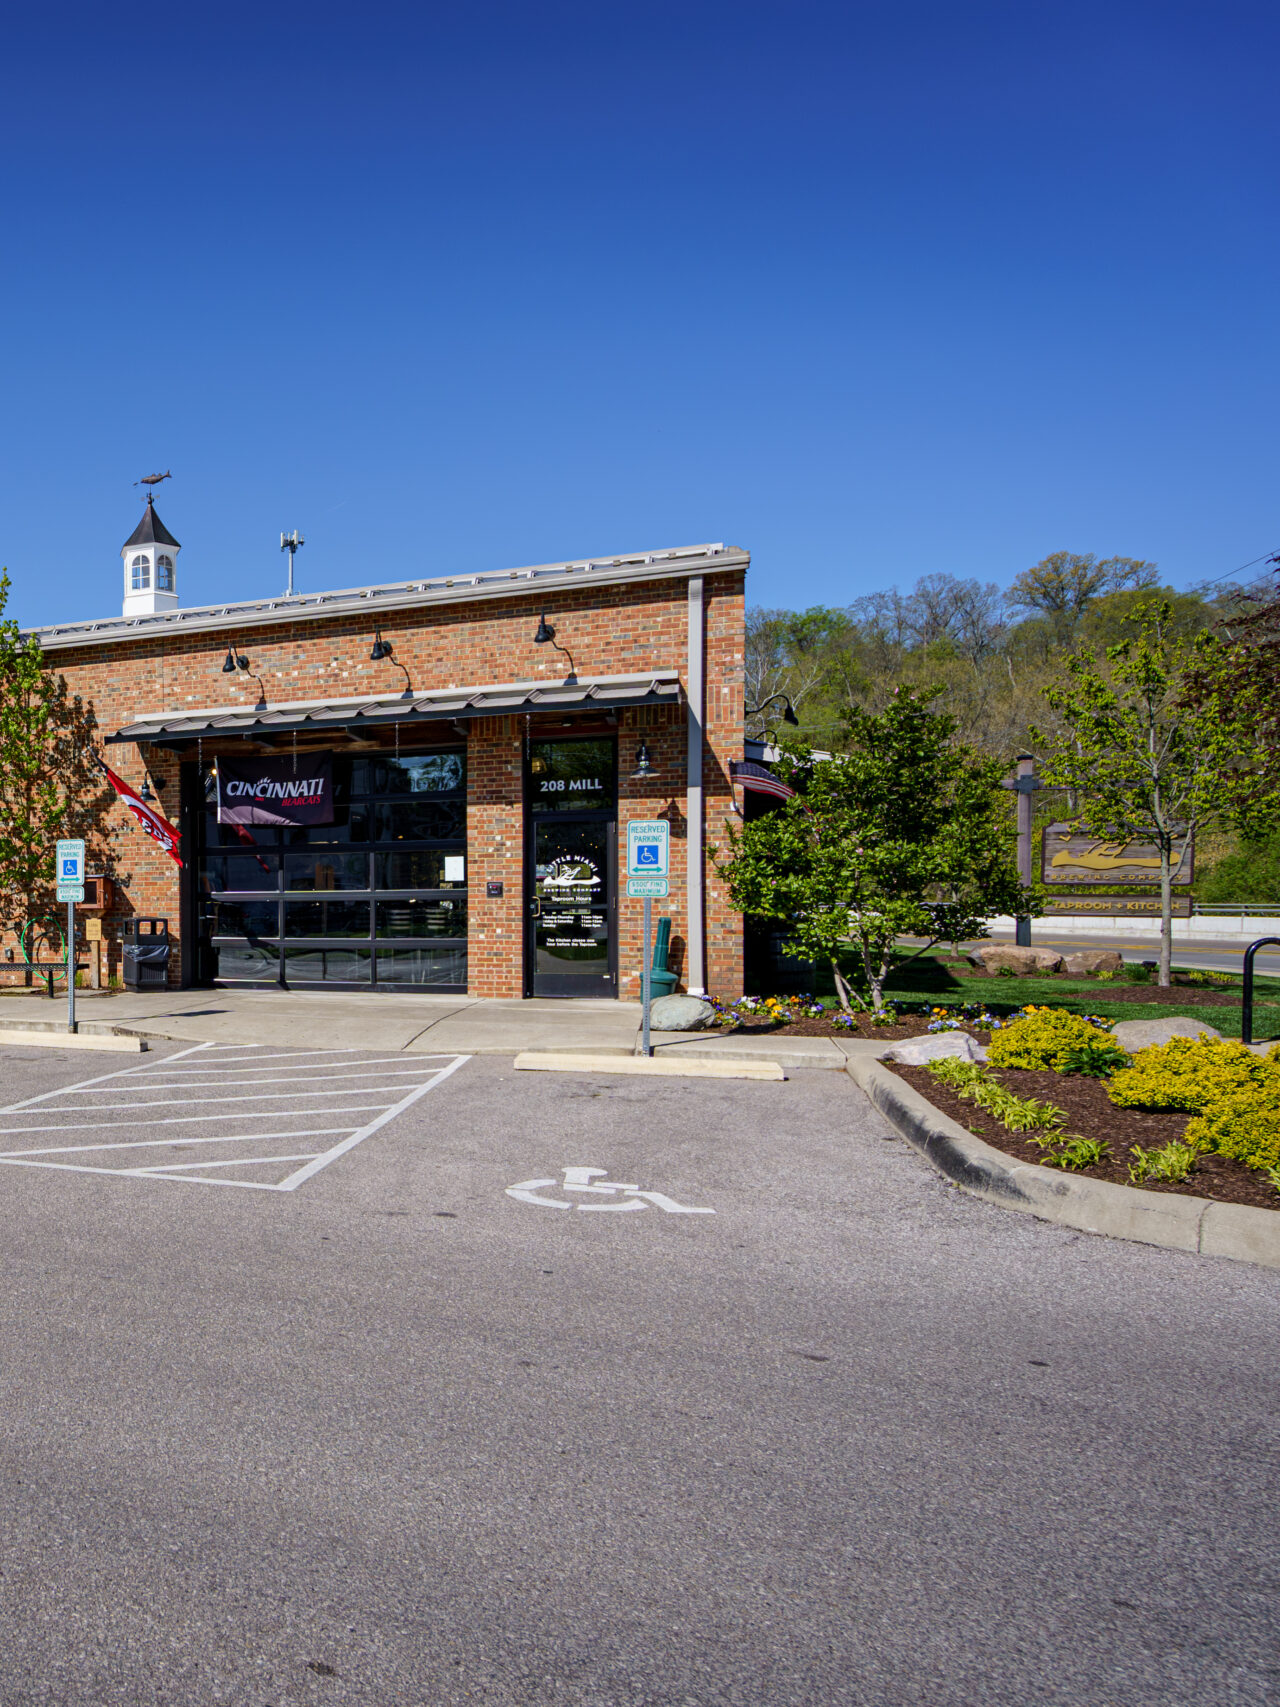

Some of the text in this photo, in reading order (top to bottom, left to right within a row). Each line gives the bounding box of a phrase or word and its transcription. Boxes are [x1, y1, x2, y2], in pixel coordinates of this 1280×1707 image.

[226, 777, 324, 799] CINCINNATI
[540, 778, 603, 792] 208 MILL
[281, 795, 321, 807] BEARCATS
[631, 825, 666, 834] RESERVED
[633, 835, 663, 843] PARKING
[546, 854, 599, 873] LITTLE MIAMI
[1054, 902, 1113, 910] TAPROOM
[1126, 902, 1181, 910] KITCHN
